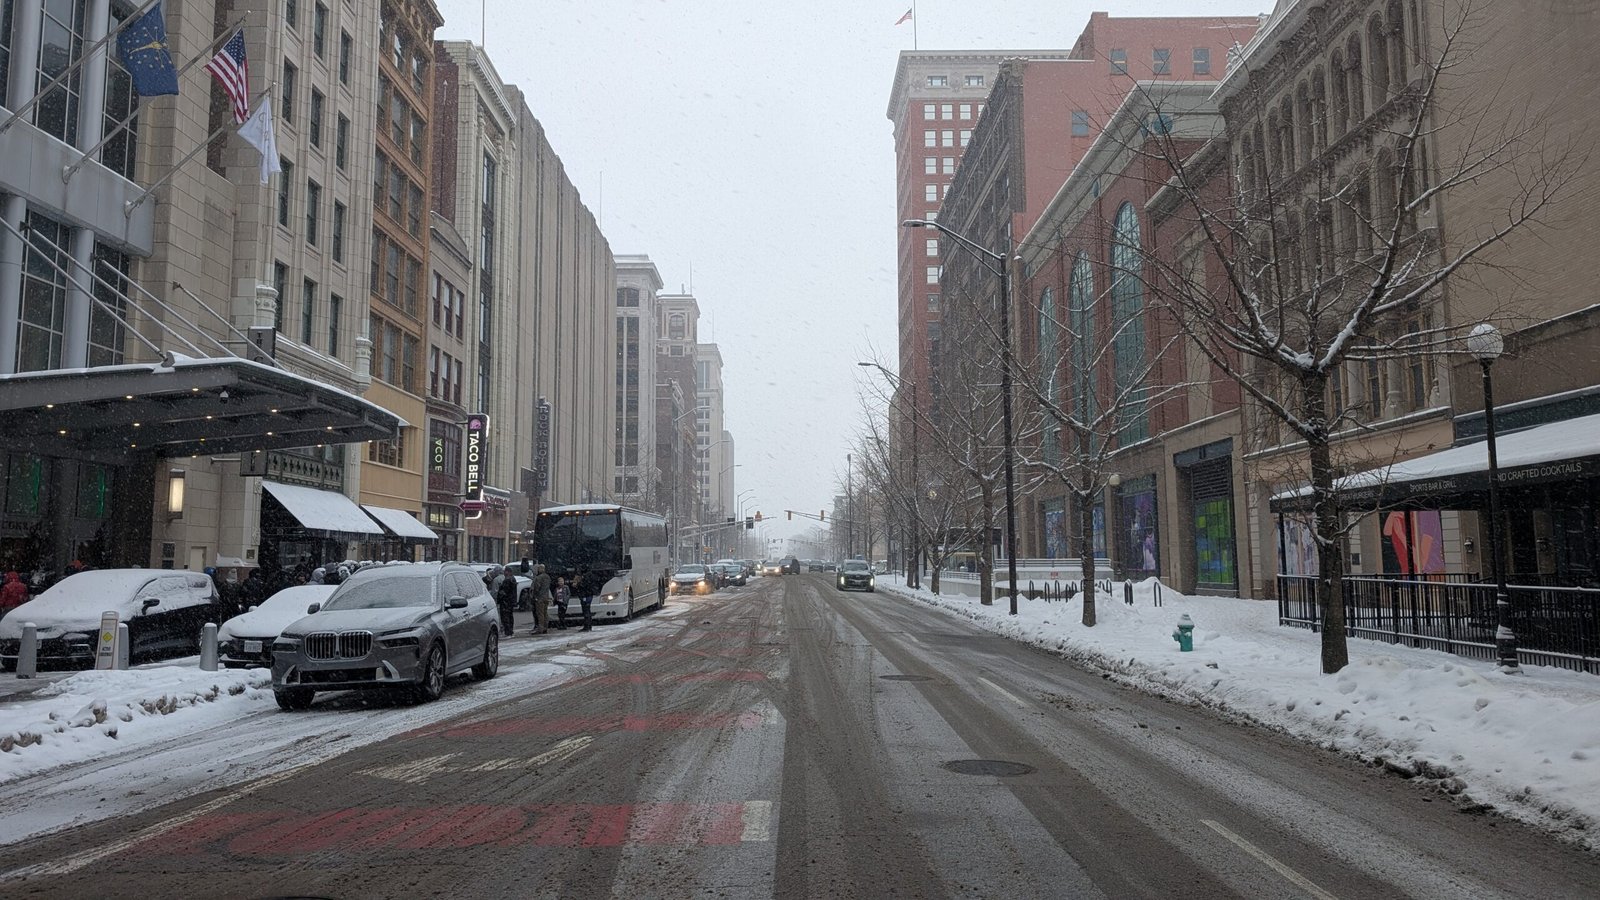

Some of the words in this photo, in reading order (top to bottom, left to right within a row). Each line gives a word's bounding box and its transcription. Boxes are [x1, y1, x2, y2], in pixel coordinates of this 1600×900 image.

[468, 431, 480, 463] TACO
[467, 464, 479, 493] BELL
[1507, 468, 1540, 480] CRAFTED
[1540, 462, 1582, 476] COCKTAILS
[1409, 483, 1428, 492] SPORTS
[1428, 481, 1438, 491] BAR
[1443, 480, 1457, 489] GRILL
